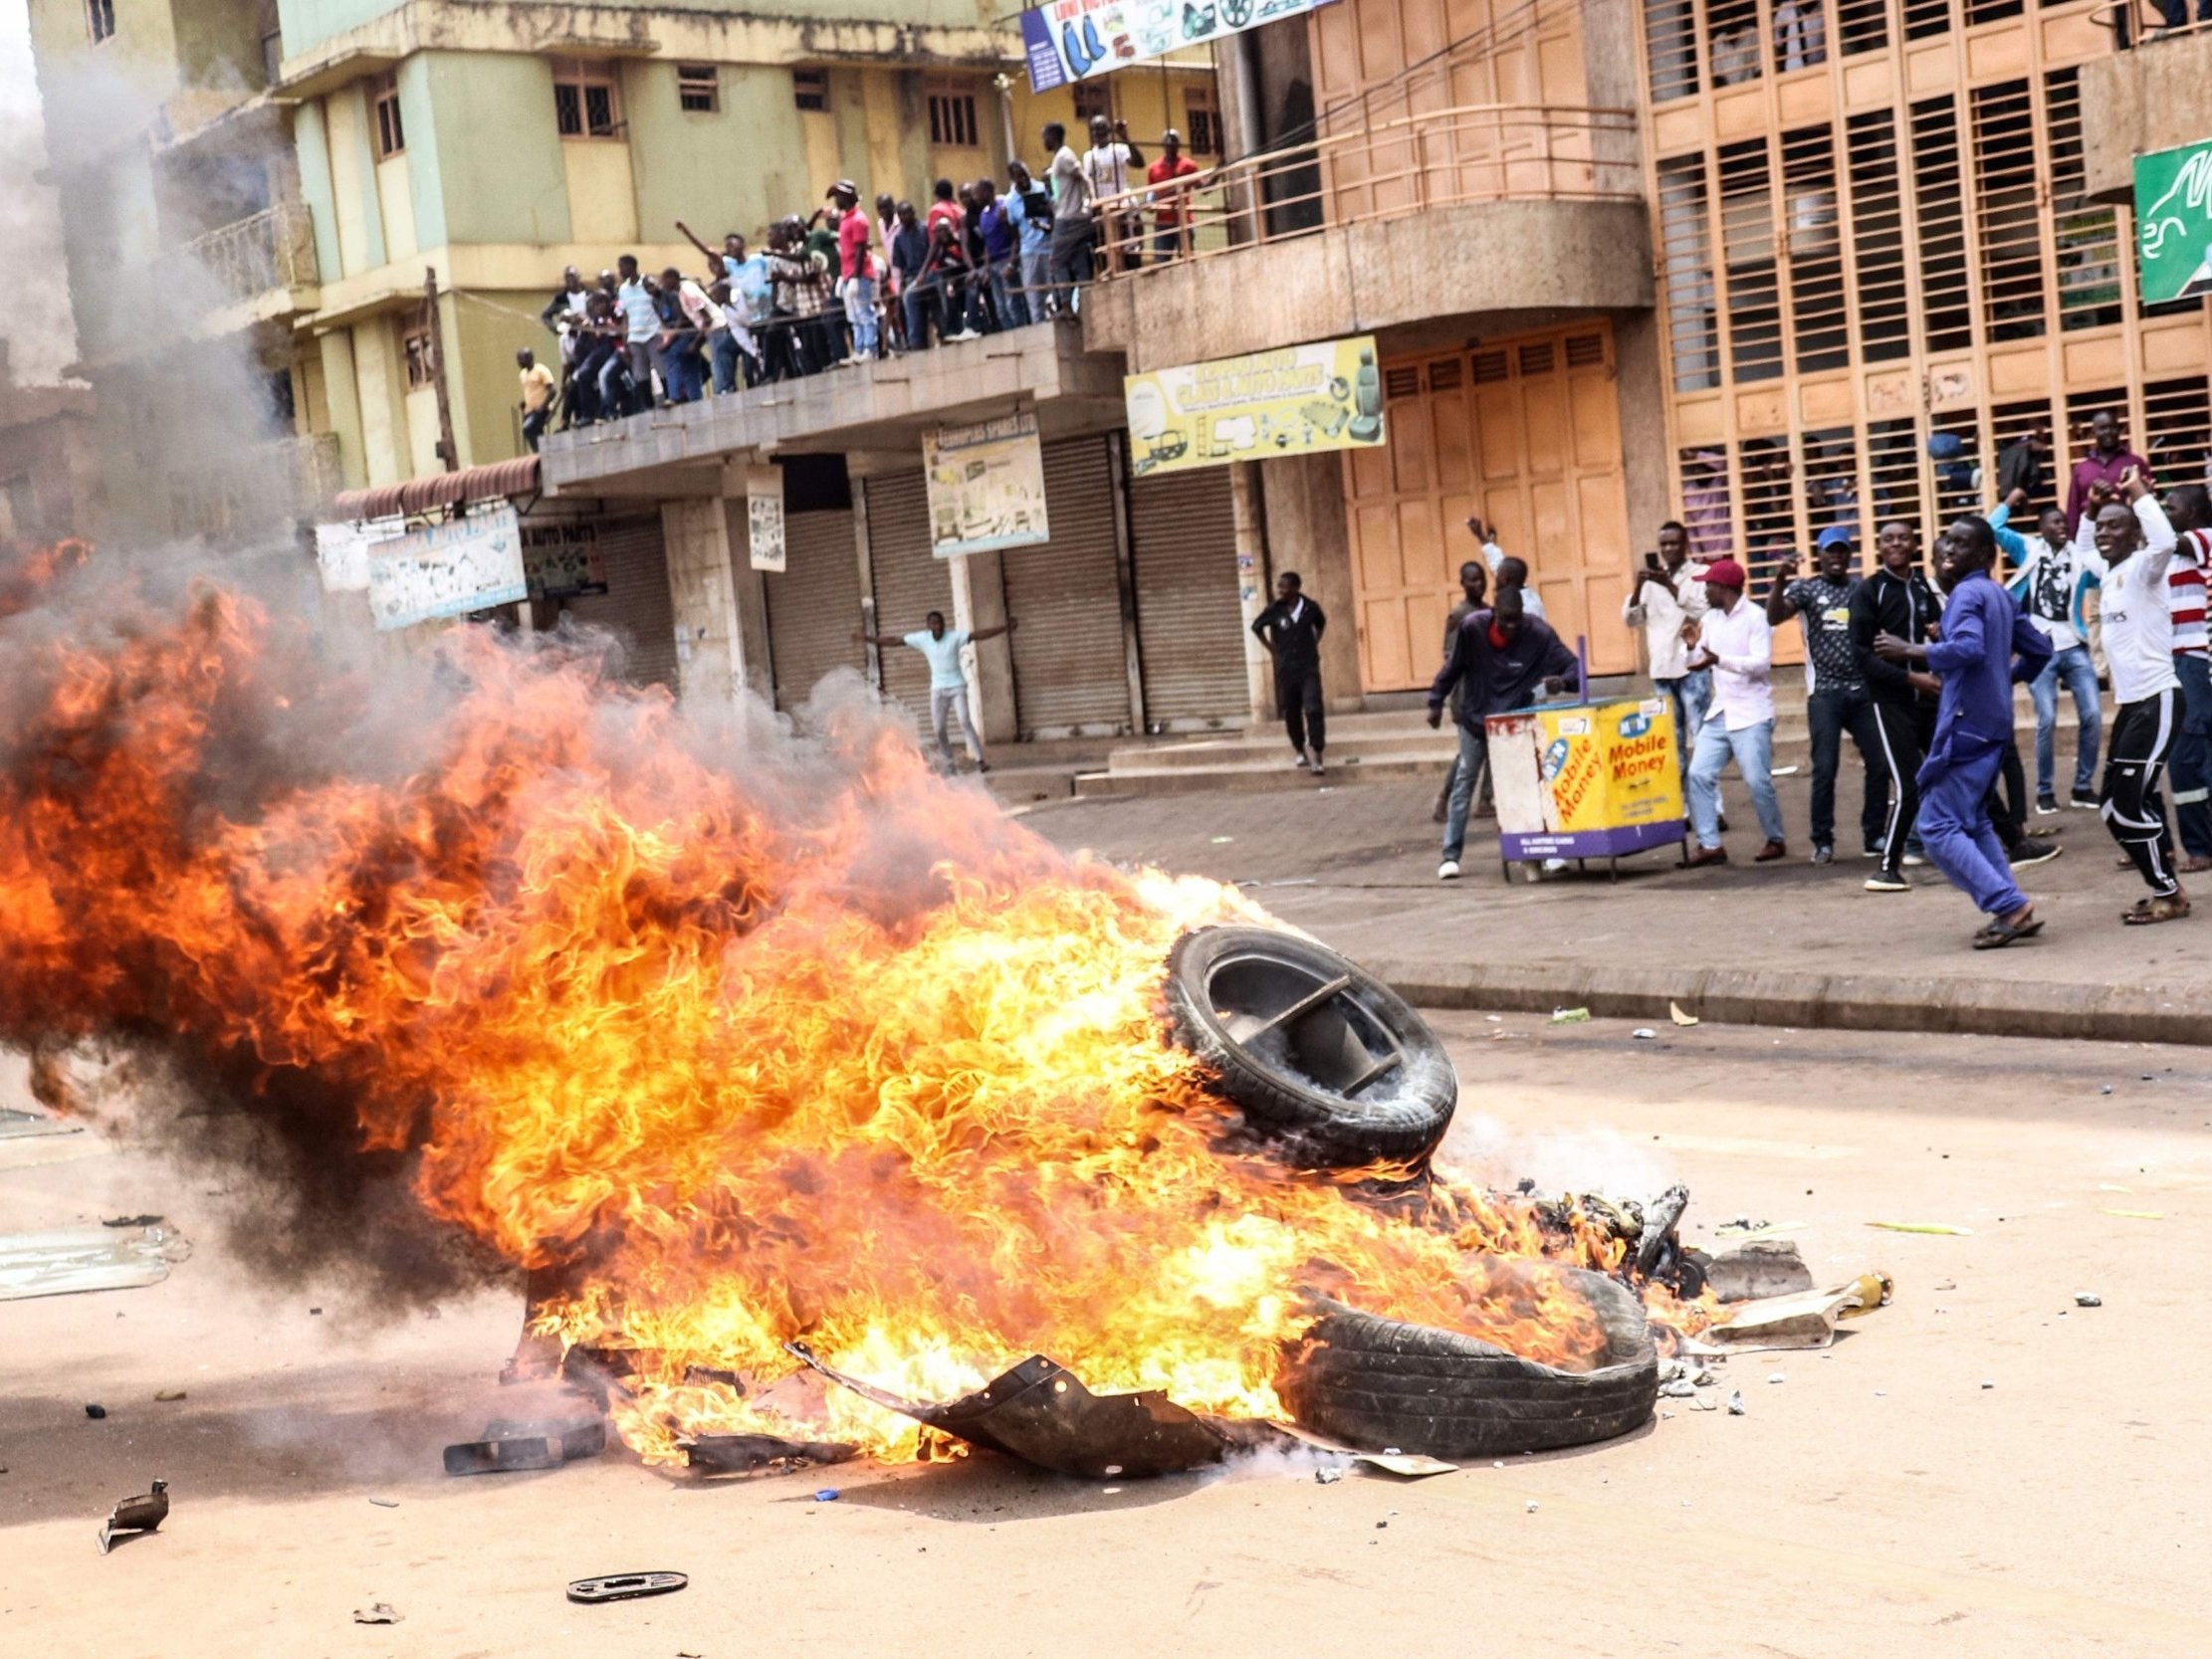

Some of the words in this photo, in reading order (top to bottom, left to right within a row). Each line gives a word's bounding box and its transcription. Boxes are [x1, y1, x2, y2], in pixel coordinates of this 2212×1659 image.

[1553, 737, 1592, 808] Mobile
[1609, 734, 1667, 764] Mobile
[1612, 754, 1666, 783] Money
[1561, 751, 1603, 825] Money
